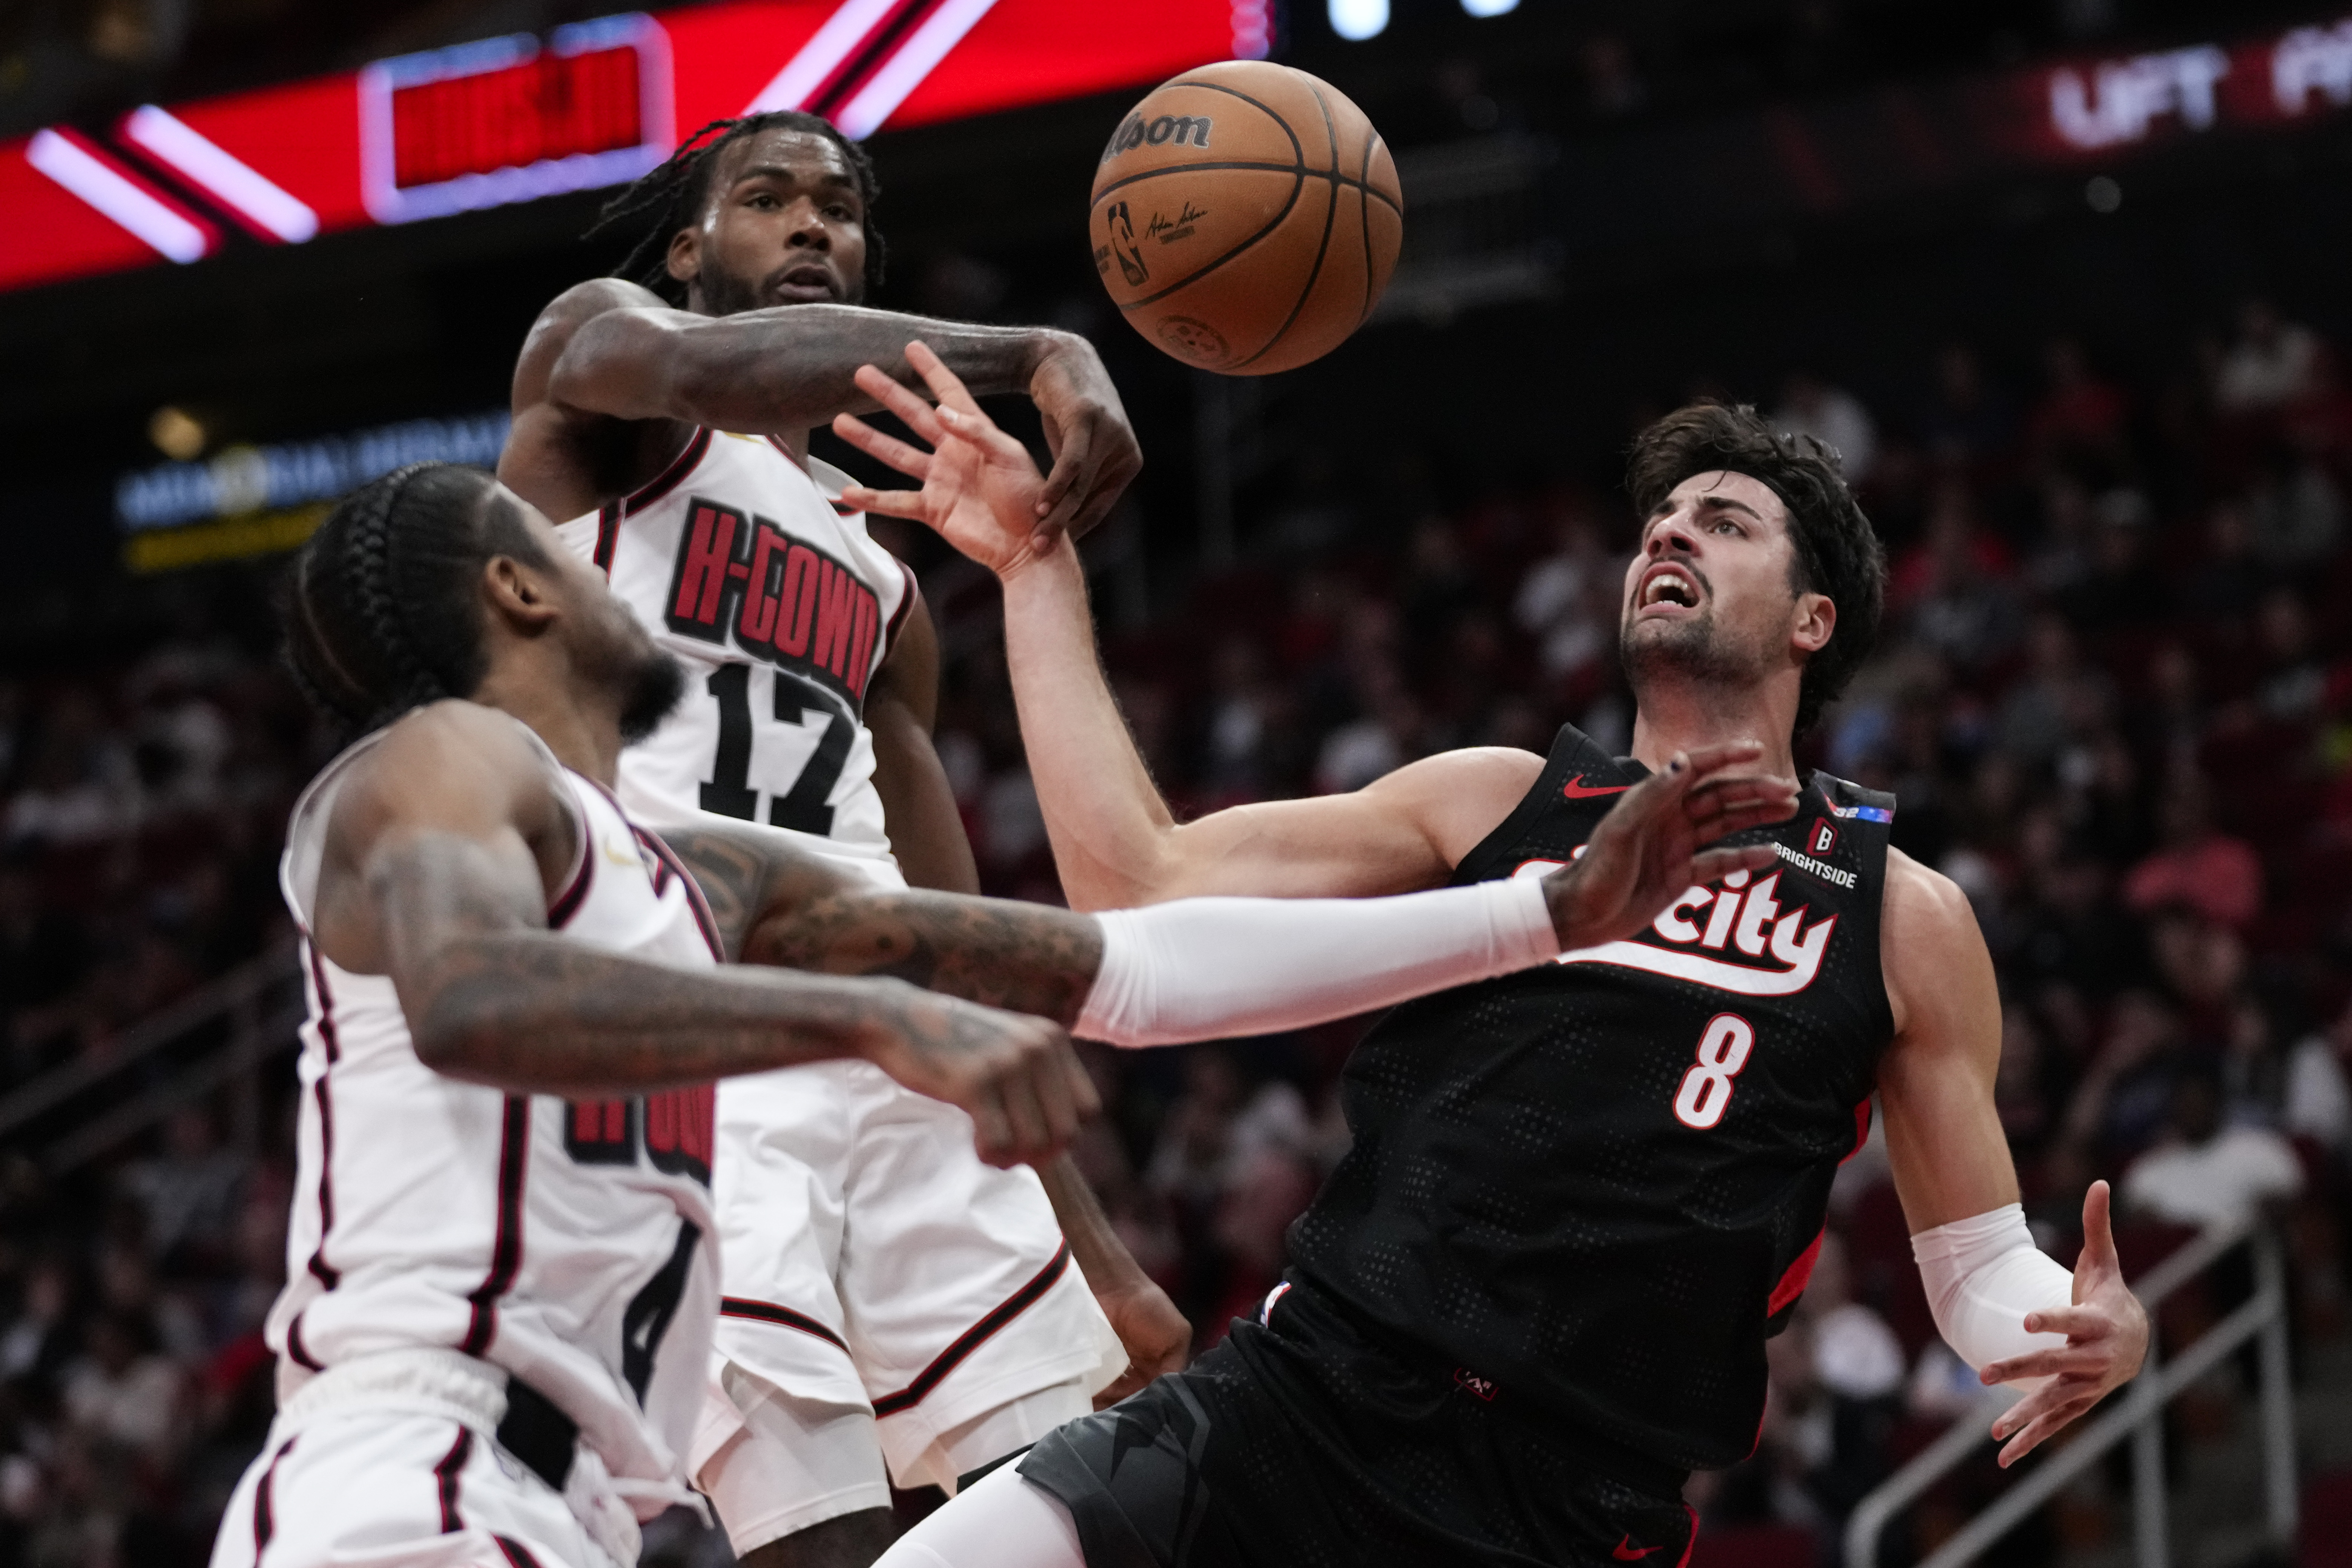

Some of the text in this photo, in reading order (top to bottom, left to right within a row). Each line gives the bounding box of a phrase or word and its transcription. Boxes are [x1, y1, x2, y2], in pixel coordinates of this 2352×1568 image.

[698, 662, 855, 836] 17
[1773, 841, 1858, 889] BRIGHTSIDE
[1816, 825, 1833, 851] B
[1652, 867, 1839, 997] city
[1672, 1012, 1756, 1130] 8
